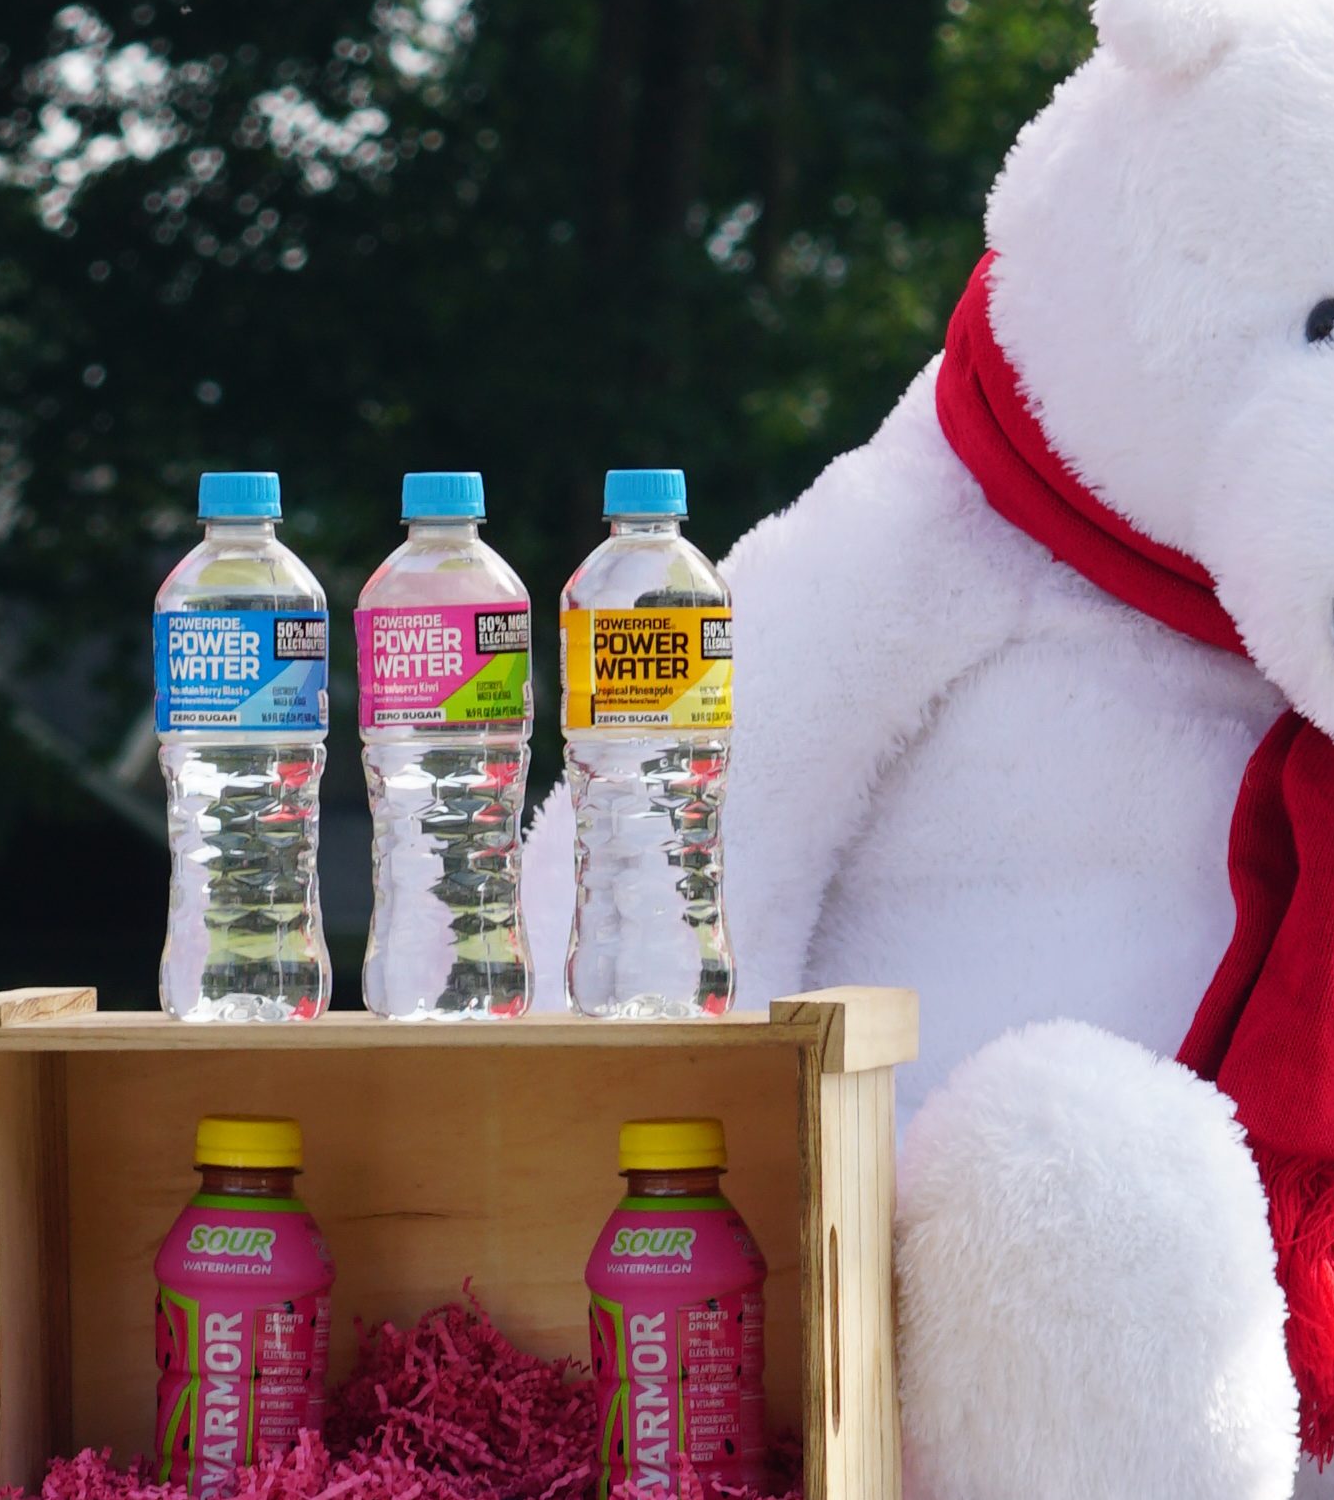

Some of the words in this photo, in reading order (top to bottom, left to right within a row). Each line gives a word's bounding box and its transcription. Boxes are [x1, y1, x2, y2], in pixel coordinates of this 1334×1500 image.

[169, 617, 241, 630] POWERADE
[373, 614, 442, 628] POWERADE
[479, 616, 506, 632] 50%
[594, 618, 671, 630] POWERADE
[277, 622, 304, 637] 50%
[169, 631, 260, 655] POWER
[373, 628, 462, 653] POWER
[594, 633, 688, 654] POWER
[169, 656, 260, 680] WATER
[374, 652, 463, 679] WATER
[595, 657, 688, 680] WATER
[419, 681, 439, 693] Kiwi
[172, 713, 196, 721] ZERO
[198, 713, 237, 721] SUGAR
[376, 711, 400, 720] ZERO
[402, 710, 442, 720] SUGAR
[597, 714, 626, 723] ZERO
[628, 714, 668, 723] SUGAR
[187, 1224, 276, 1261] SOUR
[610, 1227, 697, 1260] SOUR
[183, 1260, 271, 1275] WATERMELON
[607, 1263, 692, 1274] WATERMELON
[688, 1311, 728, 1321] SPORTS
[688, 1322, 720, 1331] DRINK
